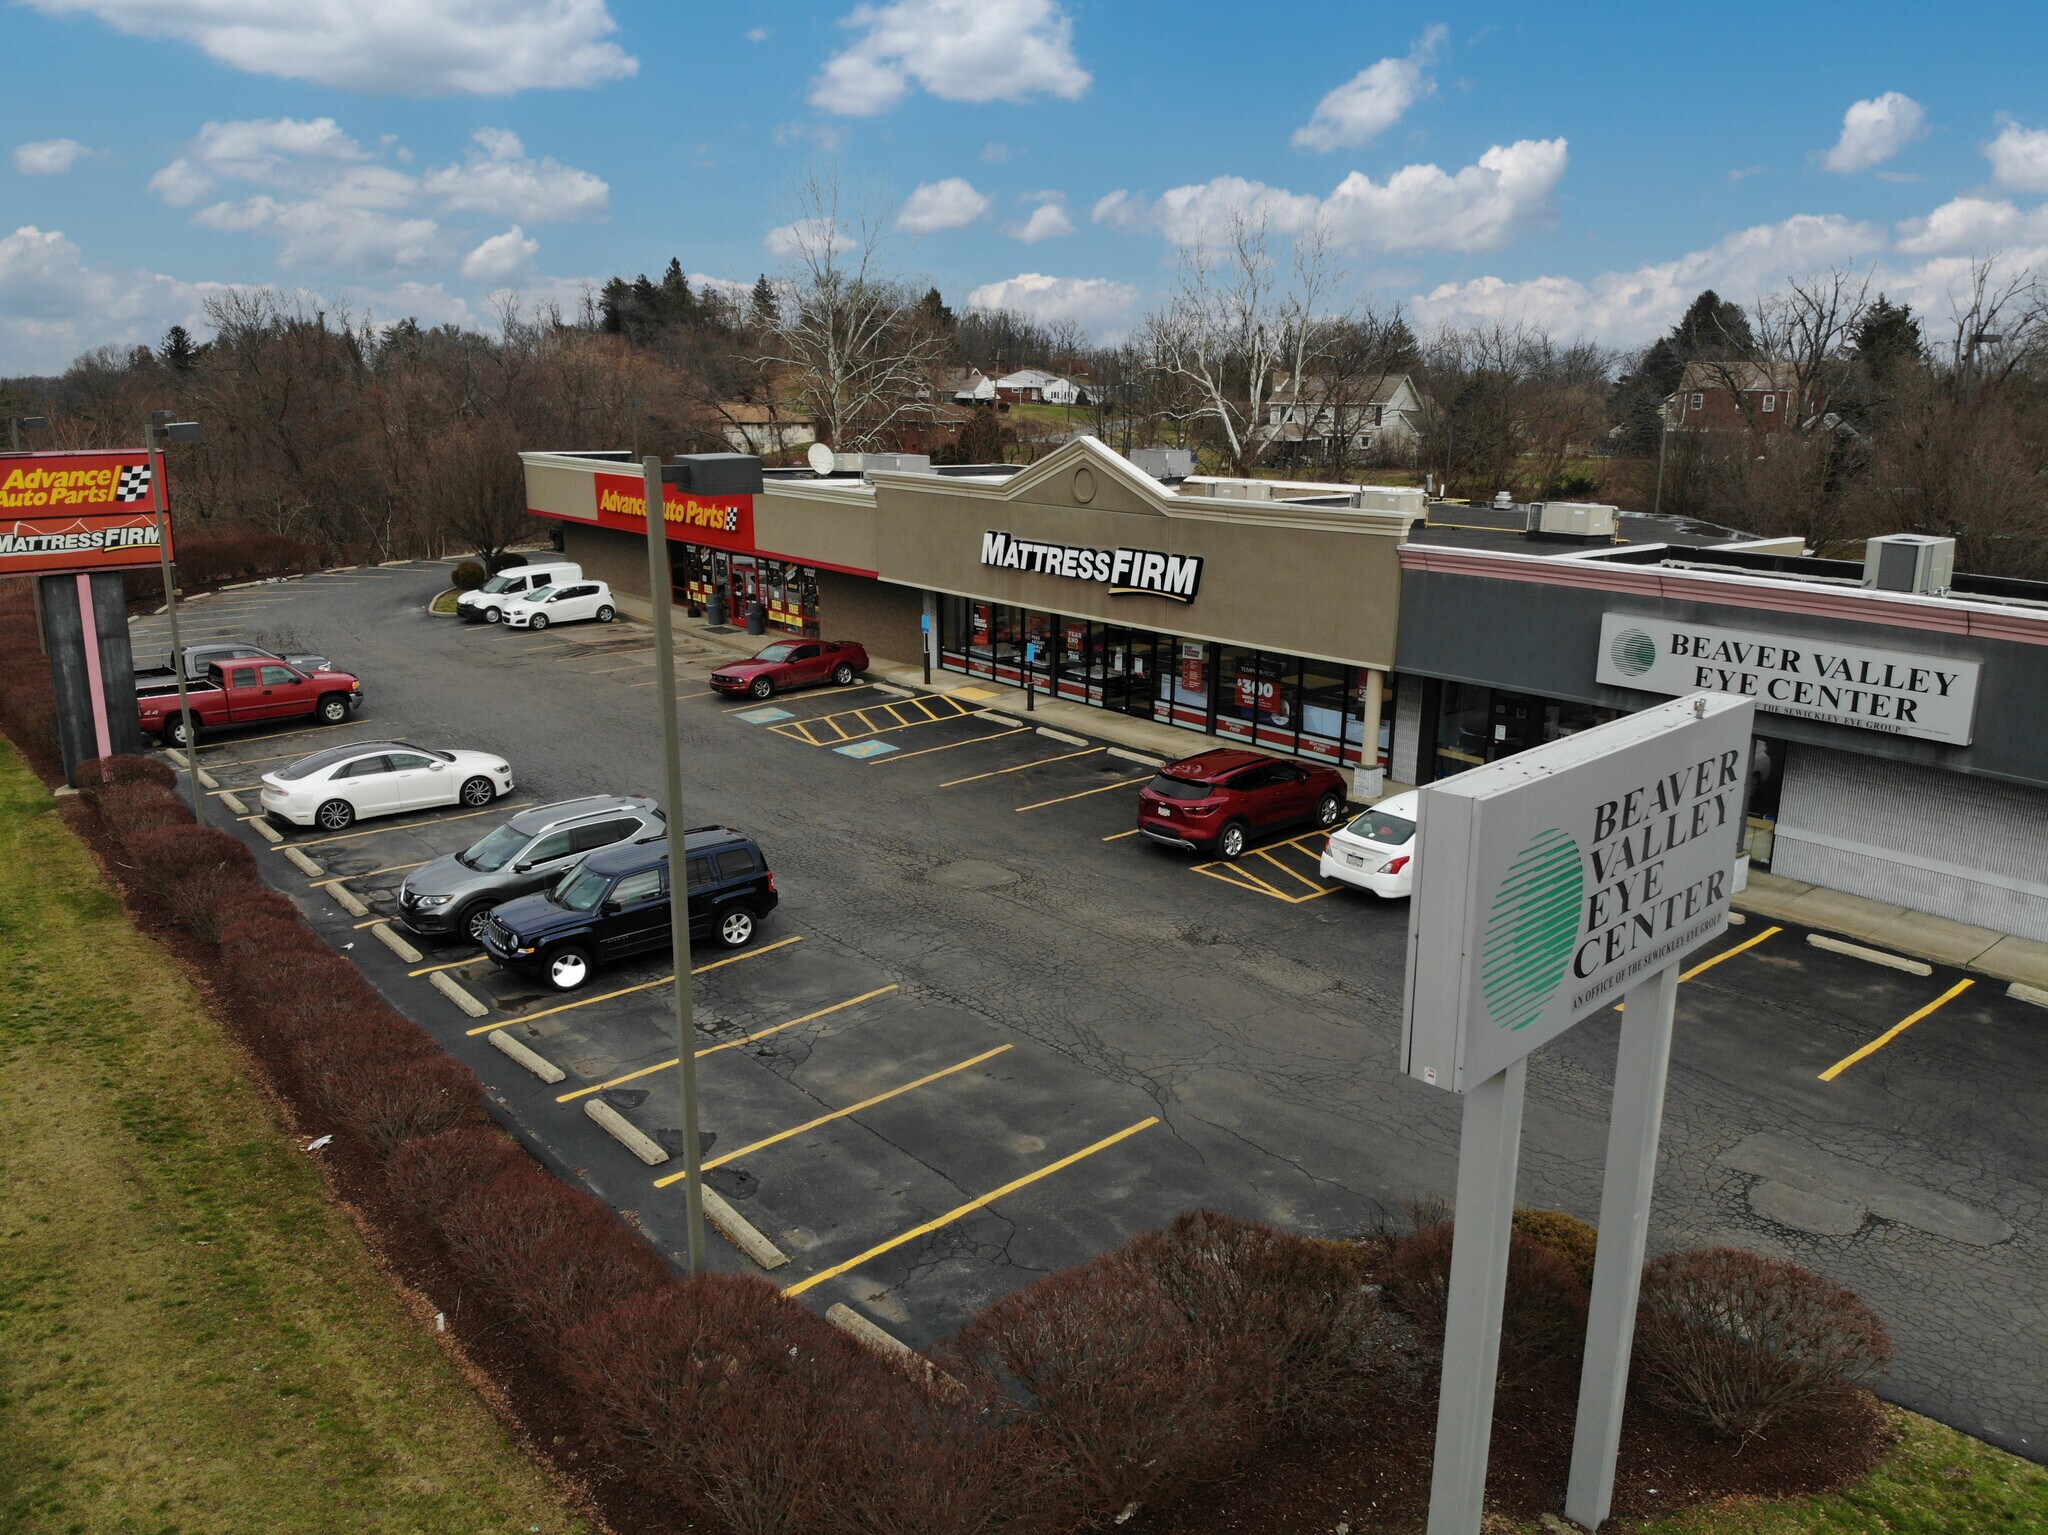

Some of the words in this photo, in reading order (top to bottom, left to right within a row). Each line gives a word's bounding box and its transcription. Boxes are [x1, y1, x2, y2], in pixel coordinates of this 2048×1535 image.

[0, 487, 48, 507] Auto
[50, 486, 108, 505] Parts
[2, 468, 112, 490] Advance
[663, 499, 684, 522] uto
[686, 500, 724, 529] Parts
[1670, 633, 1800, 673] BEAVER
[1813, 653, 1959, 697] VALLEY
[1693, 665, 1758, 696] EYE
[1767, 677, 1918, 723] CENTER
[1763, 703, 1781, 713] THE
[1784, 706, 1840, 723] SEWICKLEY
[1844, 716, 1862, 727] EYE
[1866, 721, 1901, 734] GROUP
[1591, 750, 1739, 846] BEAVER
[1590, 788, 1736, 884] VALLEY
[1573, 870, 1725, 979] CENTER
[1585, 860, 1664, 935] EYE
[1571, 995, 1584, 1010] AN
[1585, 976, 1614, 999] OFFICE
[1615, 970, 1626, 984] OF
[1628, 960, 1642, 976] THE
[1644, 936, 1686, 966] SEWICKLEY
[1686, 928, 1700, 943] EYE
[1700, 913, 1722, 934] GROUP
